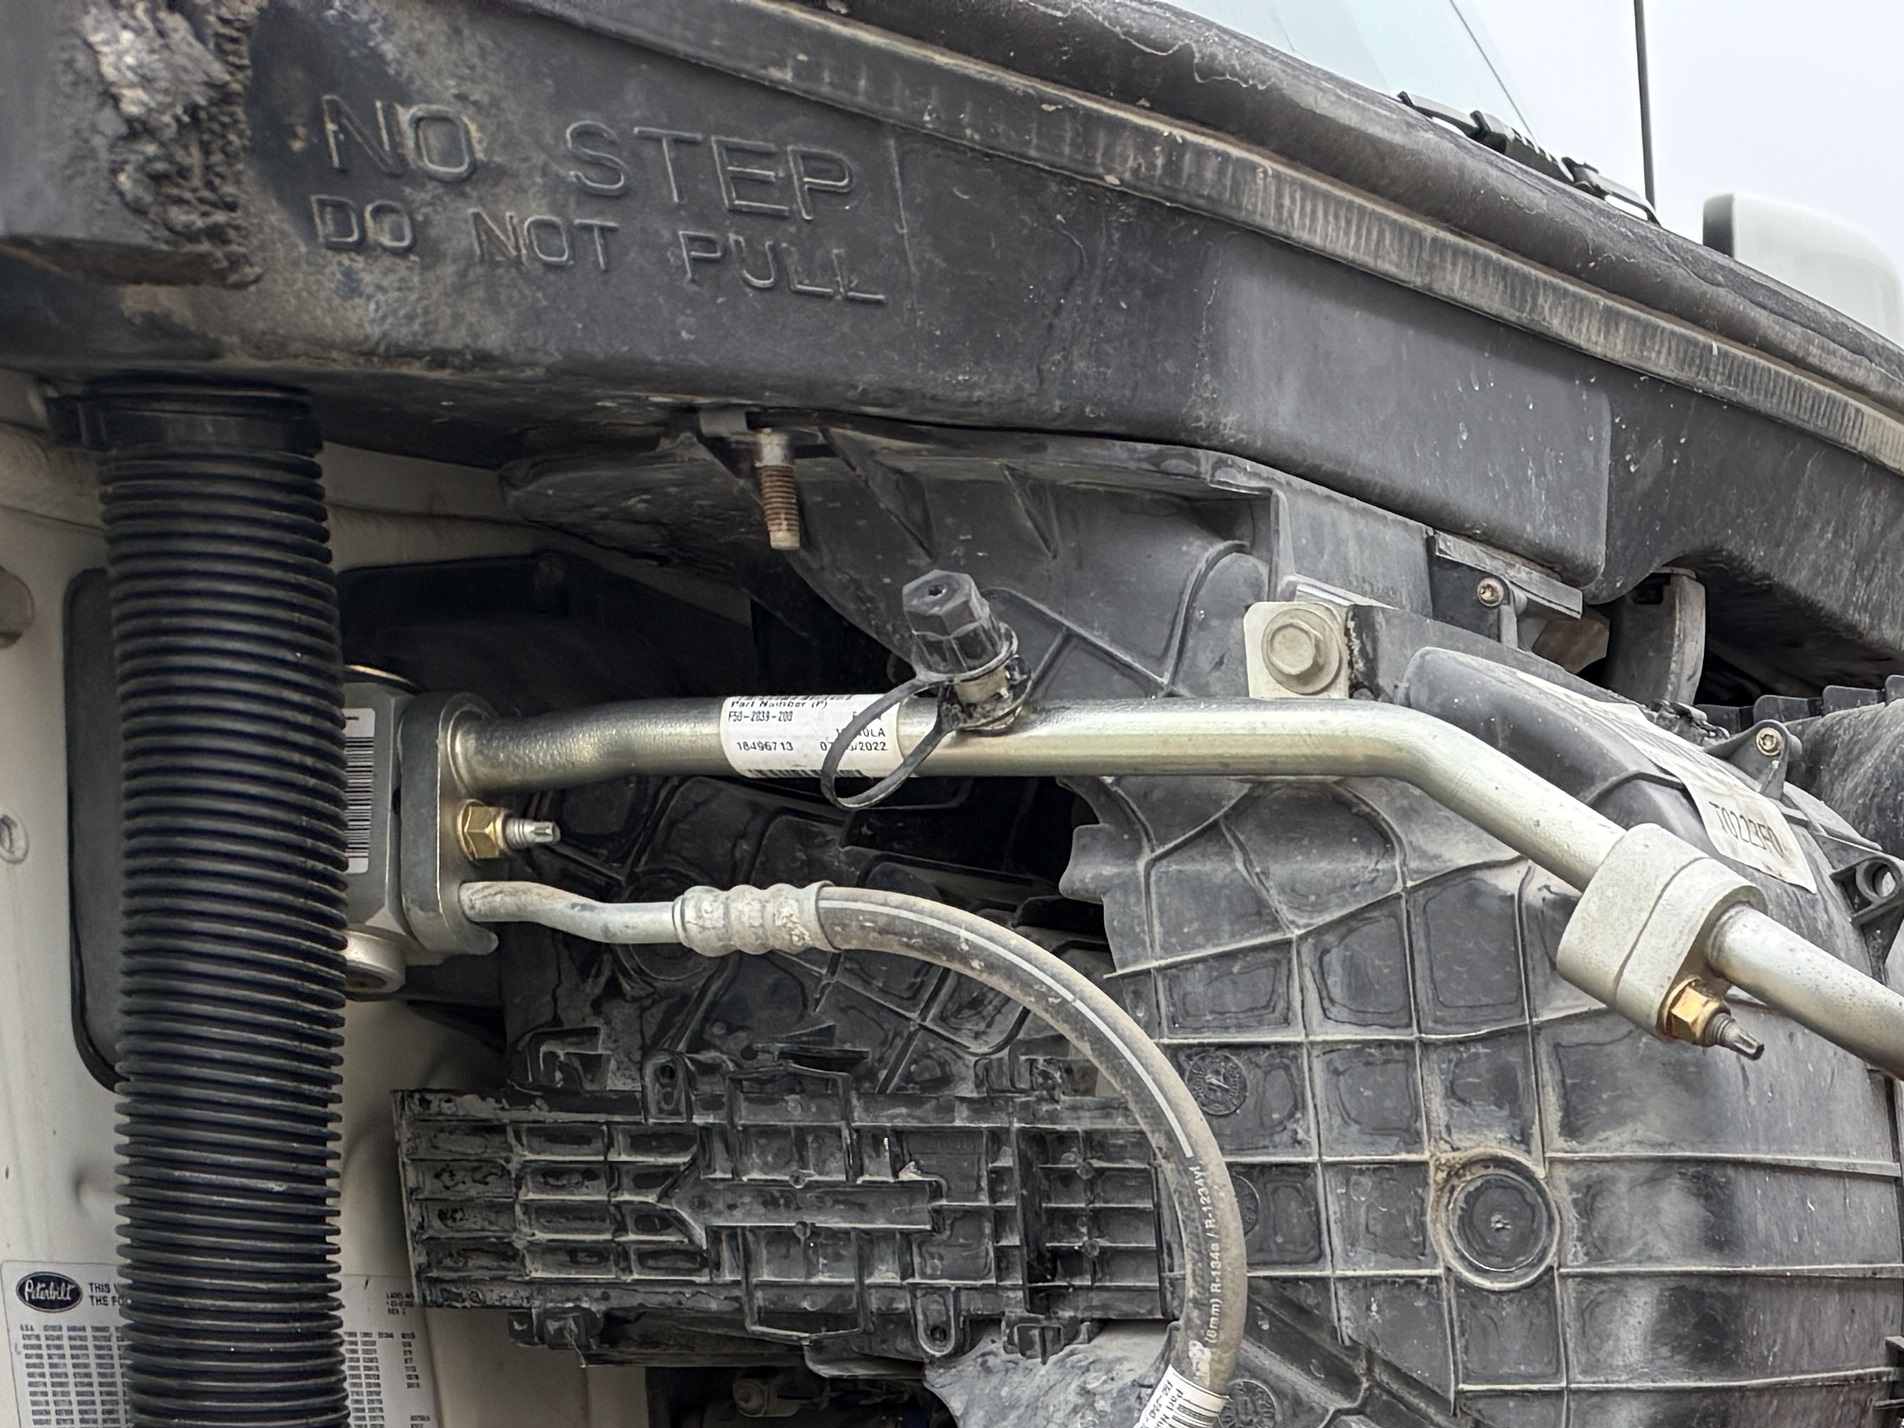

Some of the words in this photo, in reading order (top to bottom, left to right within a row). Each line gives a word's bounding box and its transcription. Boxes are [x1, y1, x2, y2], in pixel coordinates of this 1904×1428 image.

[321, 94, 478, 182] NO
[566, 119, 855, 221] STEP
[311, 194, 416, 254] DO
[470, 208, 621, 271] NOT
[678, 228, 885, 304] PULL
[737, 742, 794, 751] 18496713
[89, 1282, 110, 1293] THIS
[89, 1295, 109, 1306] THE
